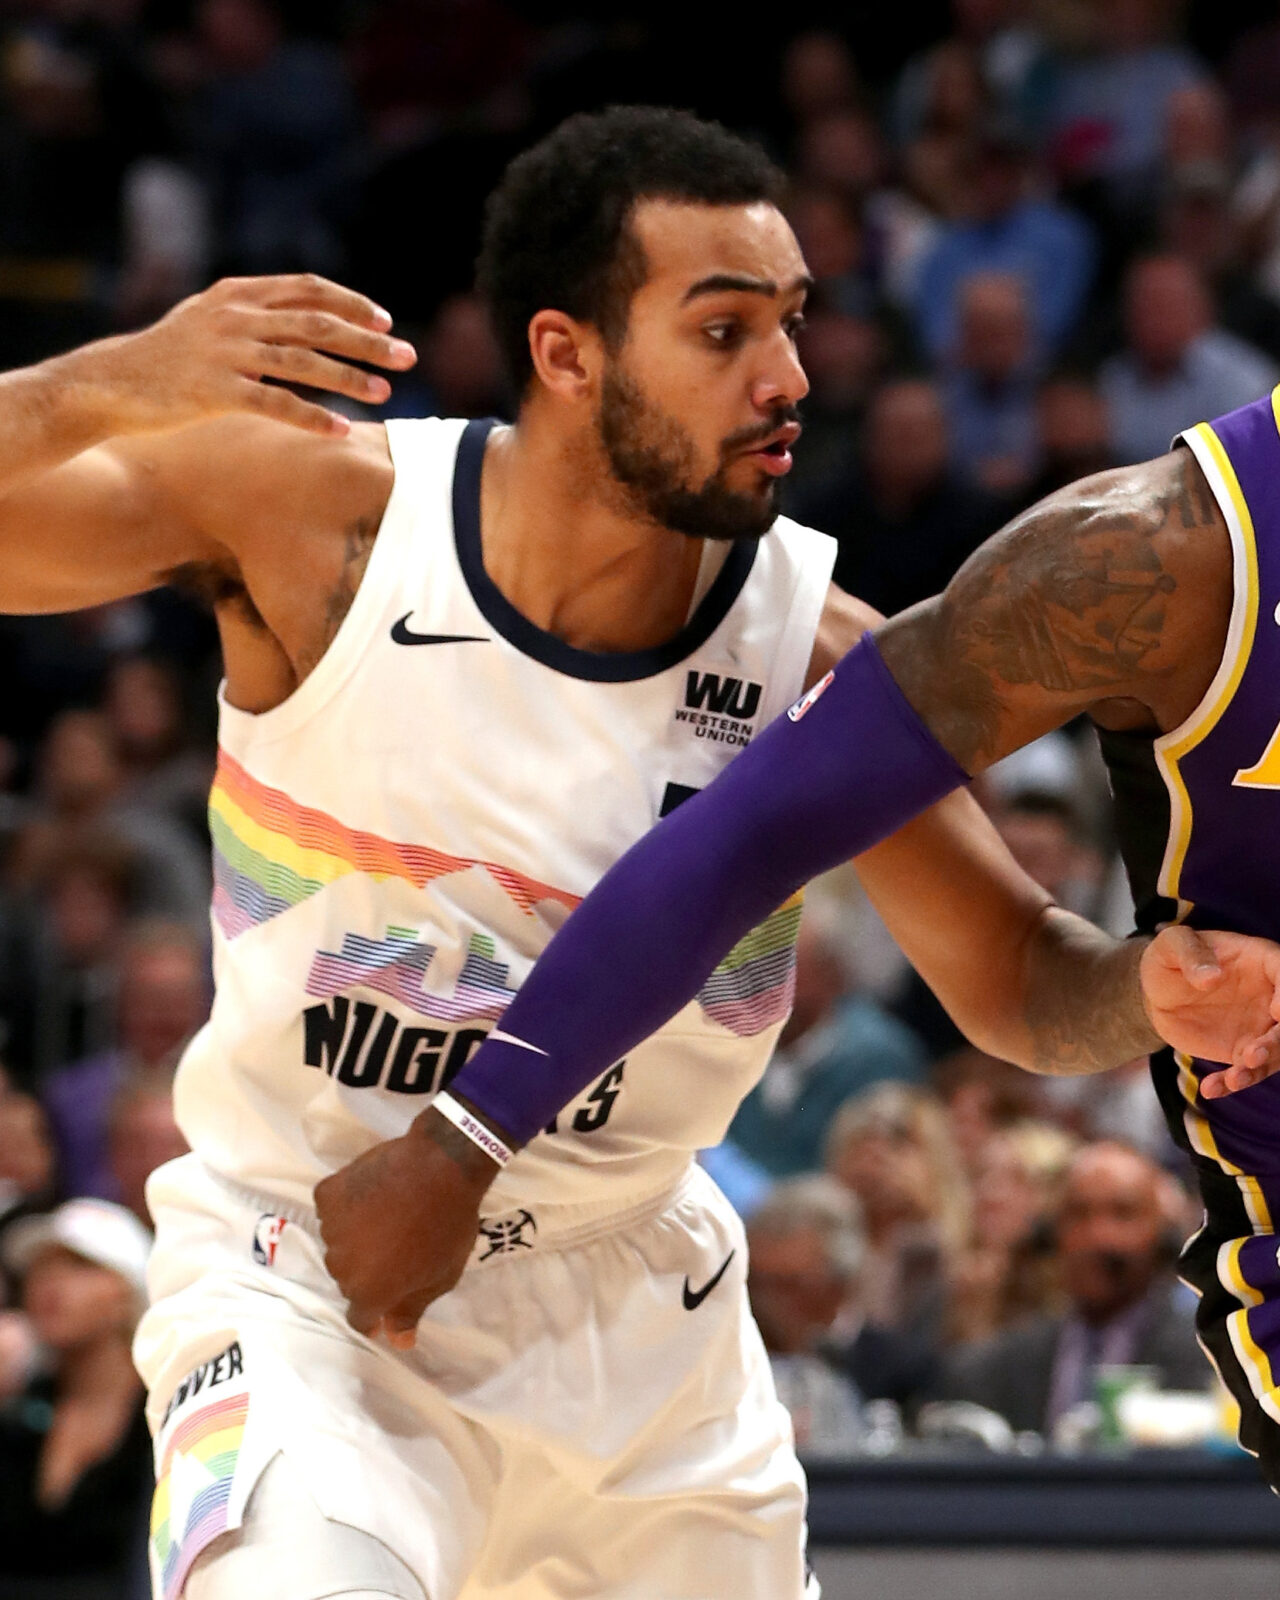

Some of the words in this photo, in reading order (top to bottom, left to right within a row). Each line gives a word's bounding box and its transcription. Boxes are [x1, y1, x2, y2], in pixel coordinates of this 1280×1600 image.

[685, 670, 762, 719] WU
[675, 709, 753, 736] WESTERN
[695, 727, 750, 748] UNION
[303, 996, 626, 1133] NUGS
